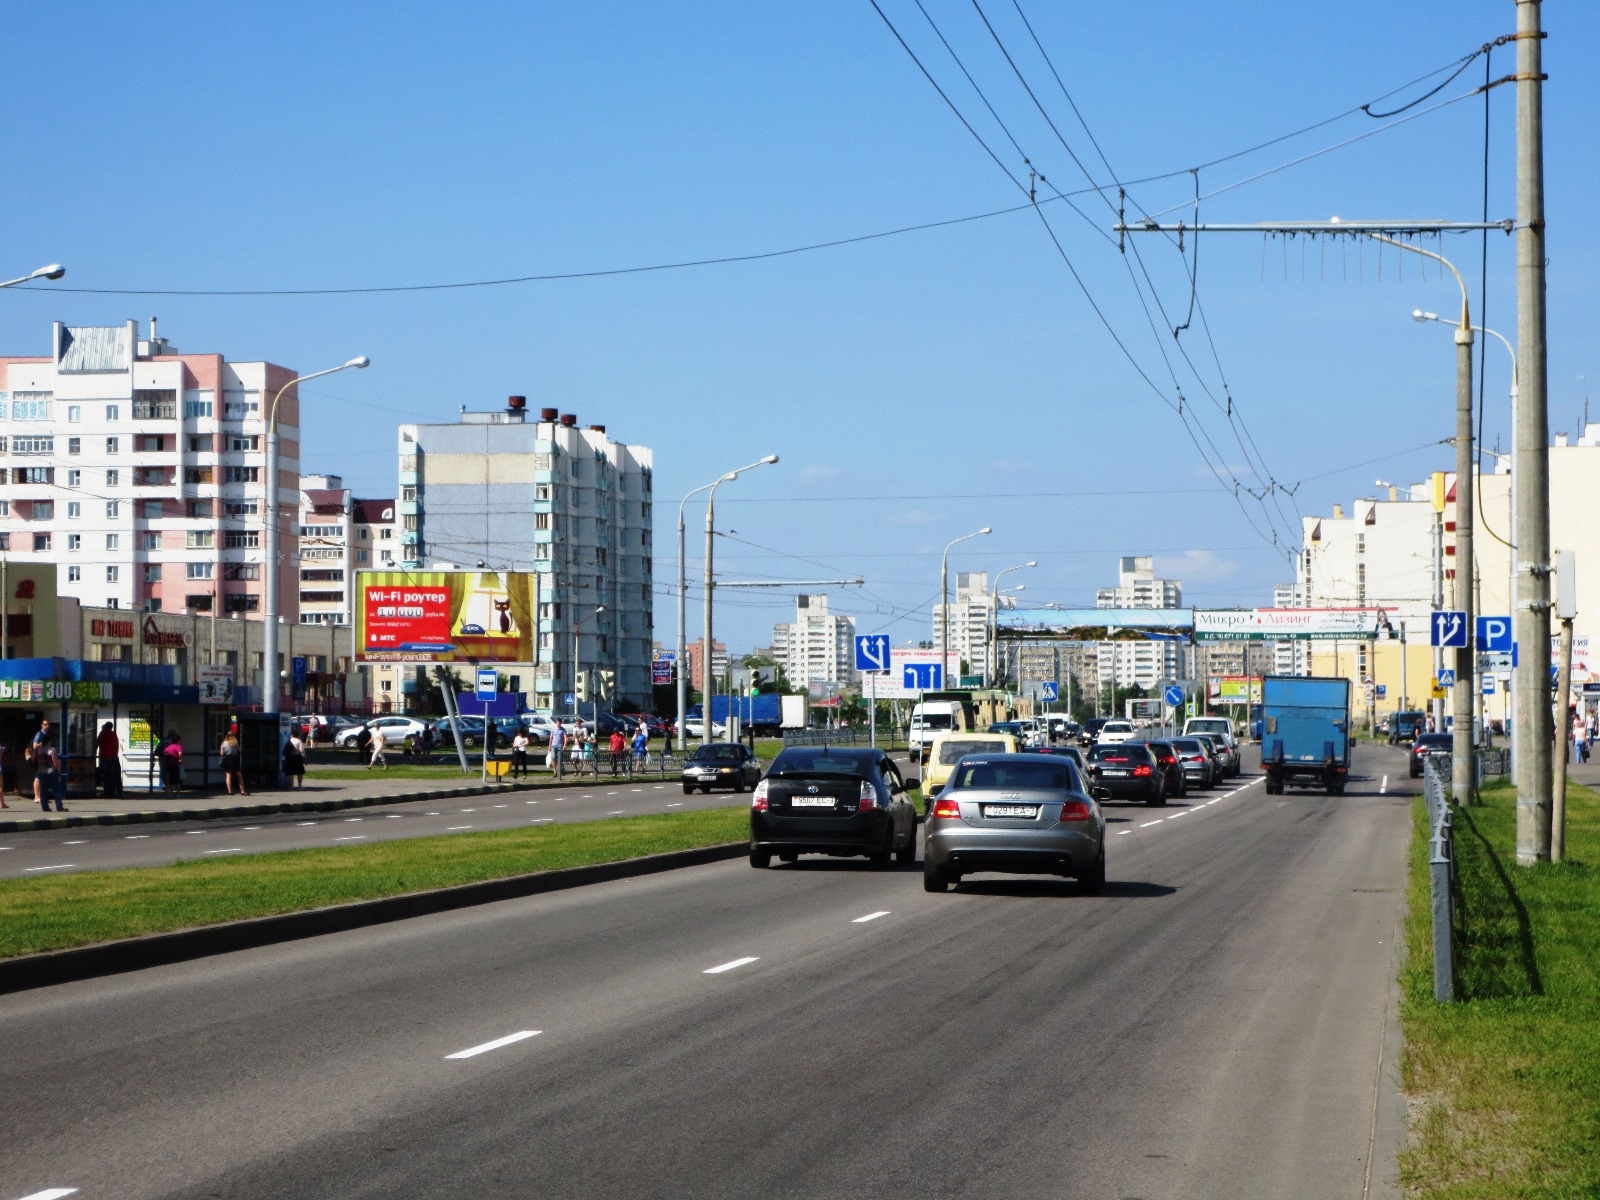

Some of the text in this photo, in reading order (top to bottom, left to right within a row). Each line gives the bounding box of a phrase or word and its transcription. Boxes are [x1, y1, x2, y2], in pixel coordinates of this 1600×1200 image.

[369, 591, 446, 604] Wi-Fi роутер
[379, 608, 394, 617] 10
[1200, 614, 1245, 627] Микро
[1266, 613, 1313, 624] Лизинг
[1486, 620, 1506, 648] P
